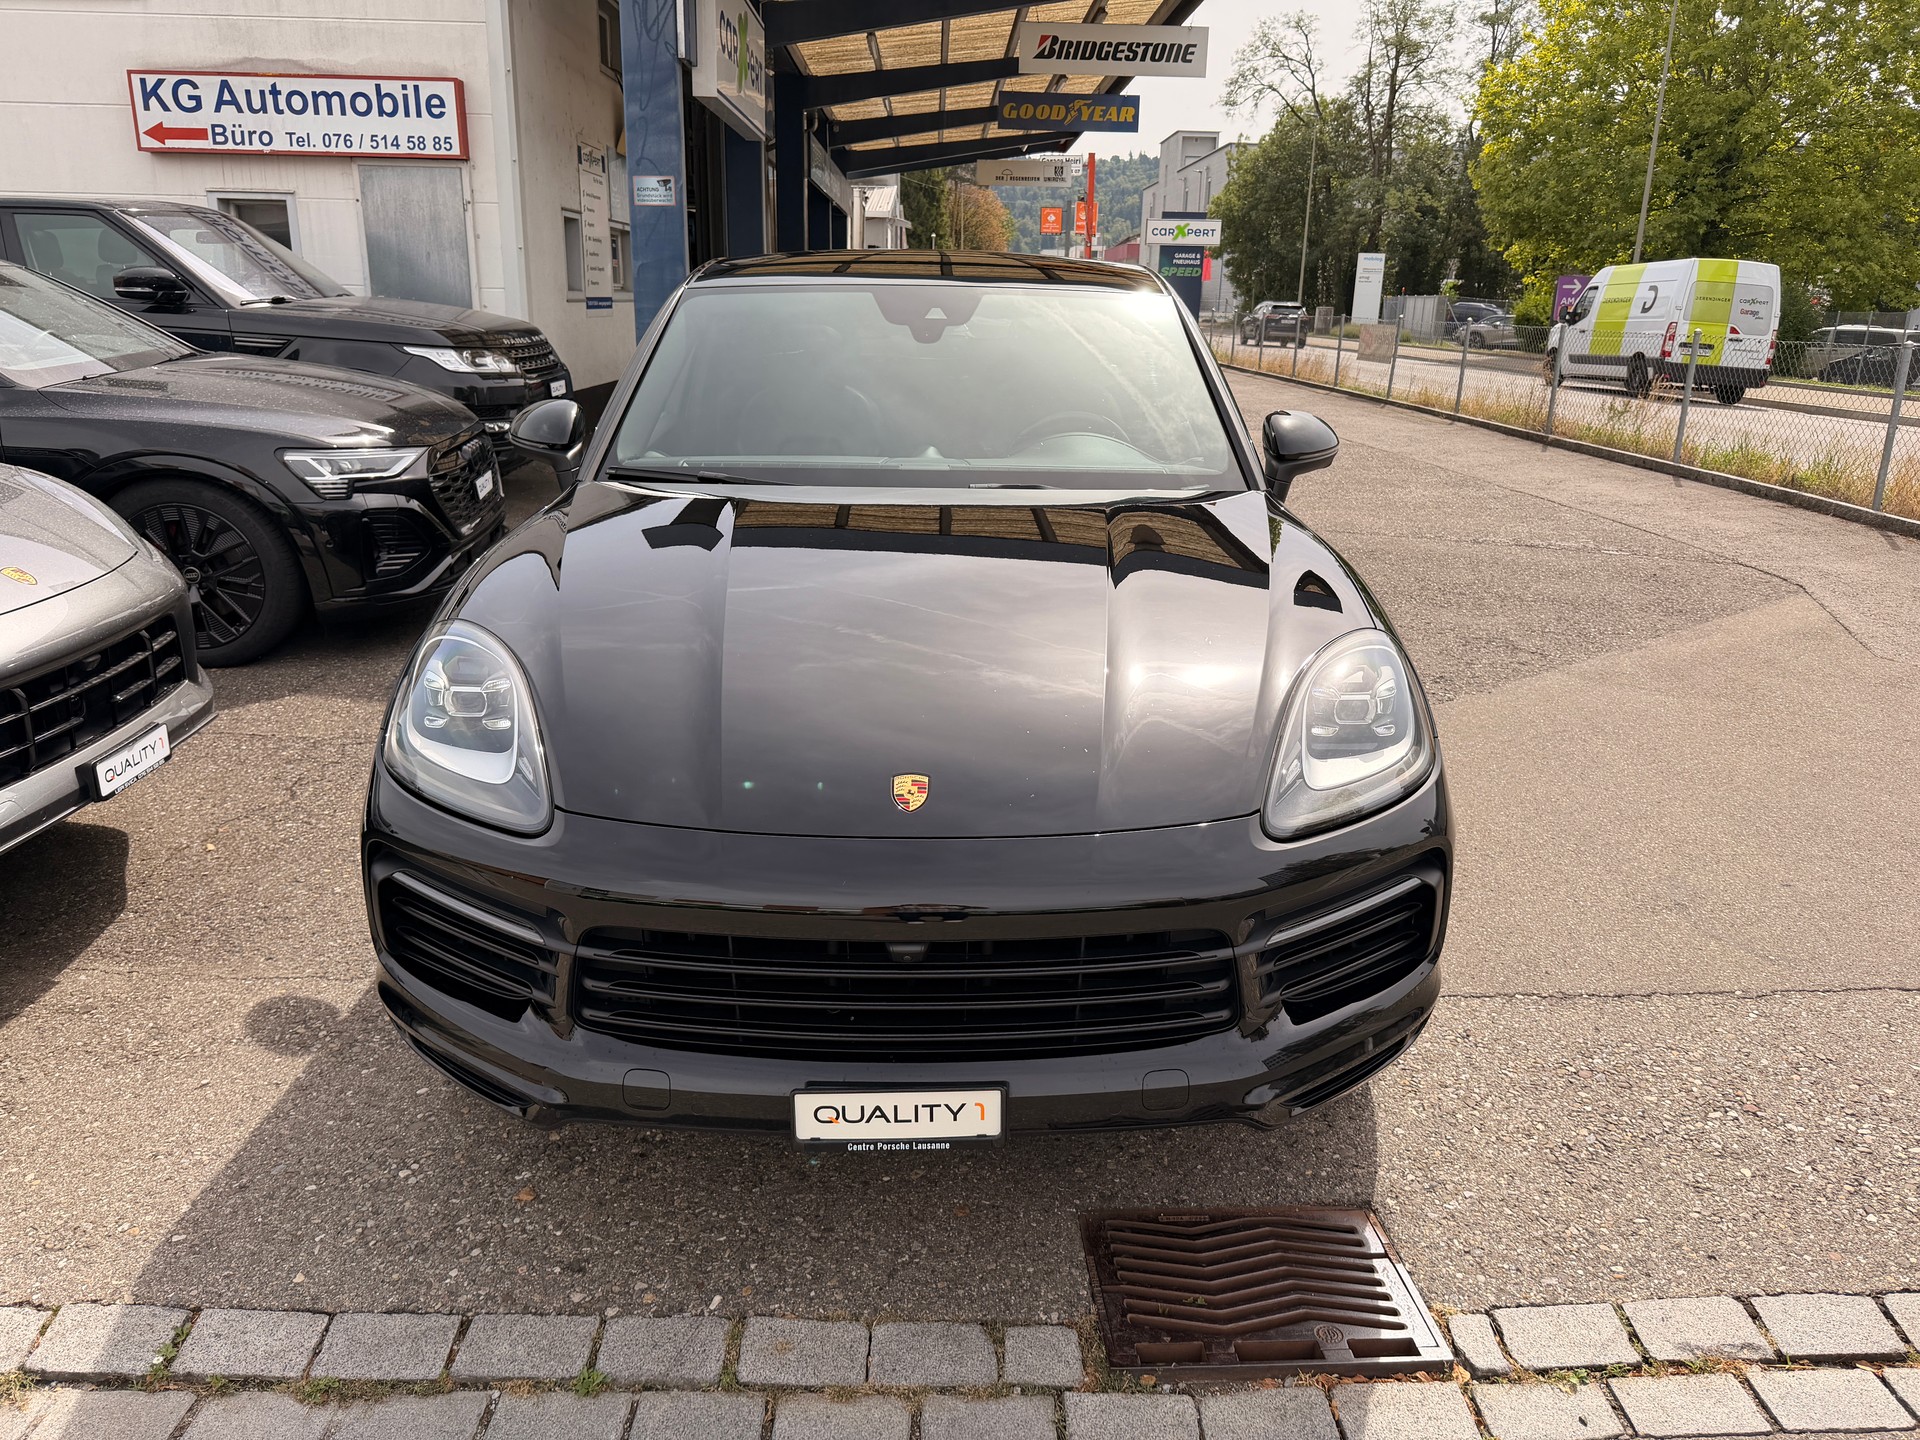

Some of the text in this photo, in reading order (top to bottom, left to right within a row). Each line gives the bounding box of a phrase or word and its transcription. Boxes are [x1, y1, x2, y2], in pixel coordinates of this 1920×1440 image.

[1033, 34, 1197, 64] BRIDGESTONE
[139, 77, 447, 119] KG Automobile
[210, 123, 453, 152] Büro Tel. 076 / 514 58 85
[1160, 266, 1202, 277] SPEED
[1740, 308, 1760, 318] Garage
[105, 740, 157, 783] QUALITY
[813, 1102, 985, 1124] QUALITY 1
[847, 1141, 950, 1151] Centre Porsche Lausanne
